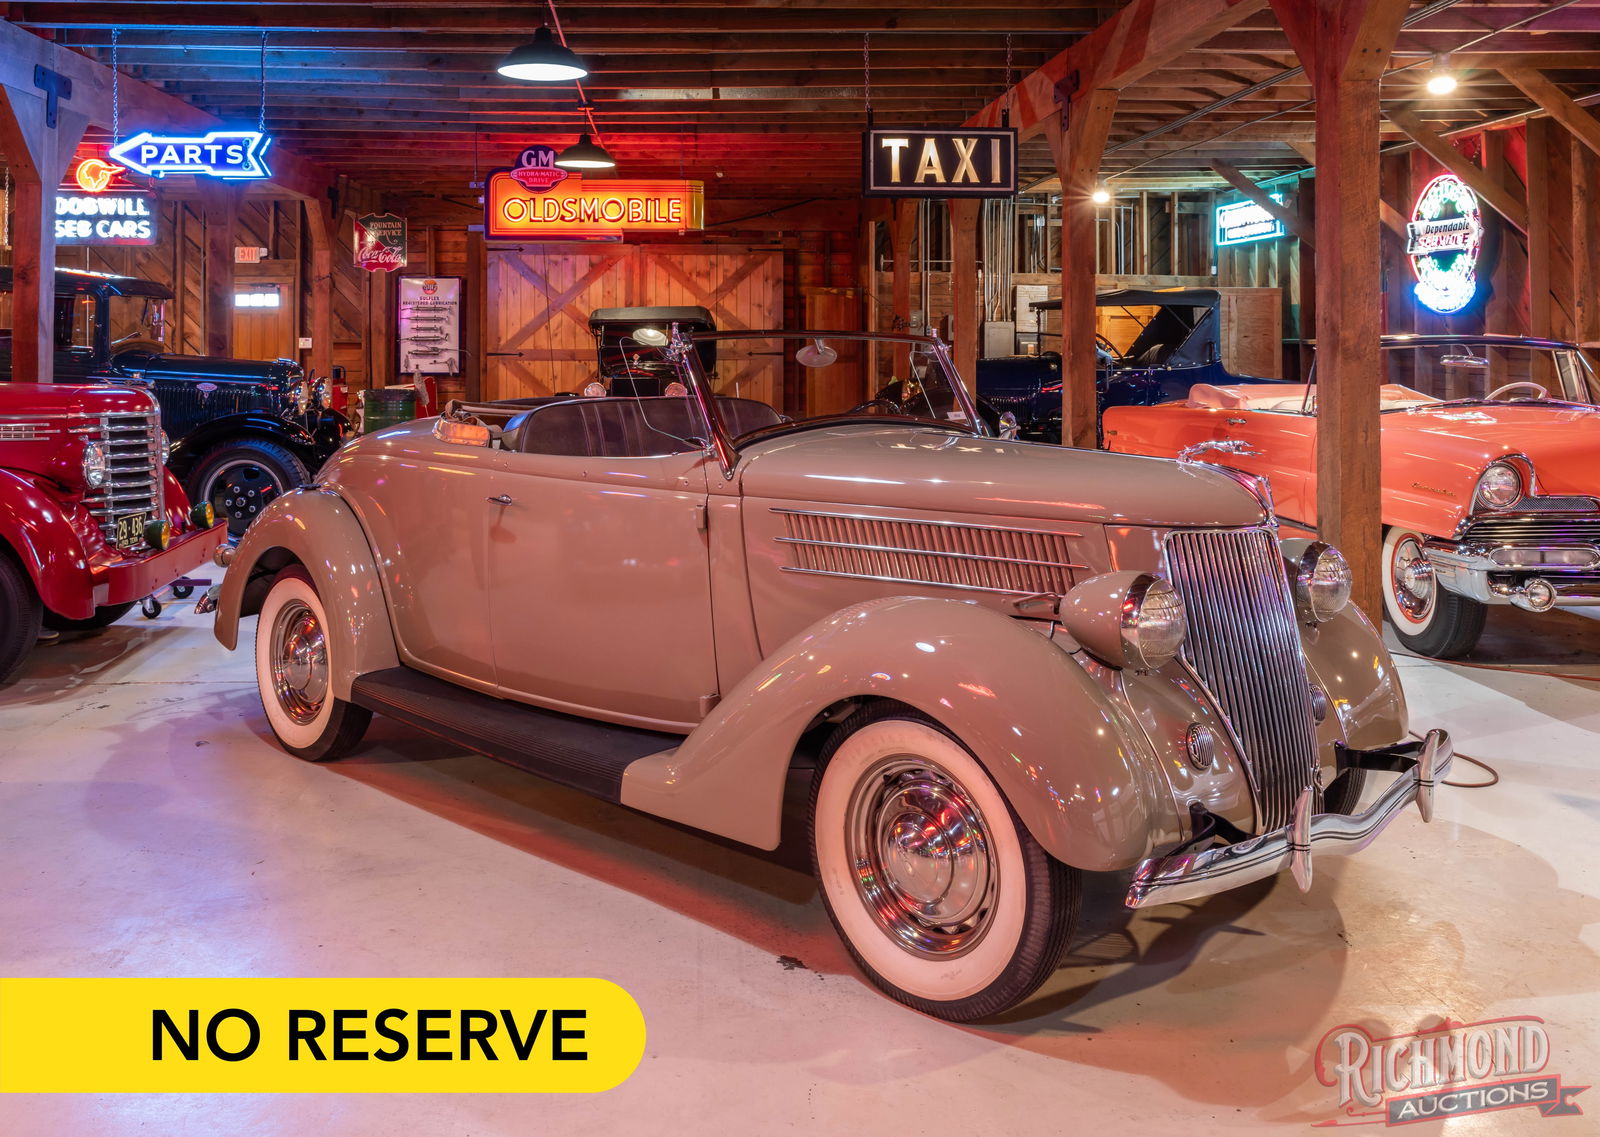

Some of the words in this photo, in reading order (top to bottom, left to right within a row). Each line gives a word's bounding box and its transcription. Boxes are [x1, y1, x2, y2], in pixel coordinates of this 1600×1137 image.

[141, 144, 244, 164] PARTS
[521, 150, 554, 168] GM
[881, 137, 1001, 183] TAXI
[502, 197, 682, 223] OLDSMOBILE
[96, 219, 151, 239] CARS
[369, 221, 402, 229] FOUNTAIN
[1425, 221, 1470, 235] Dependable
[239, 247, 257, 261] EXIT
[357, 246, 403, 263] Coca-Cola
